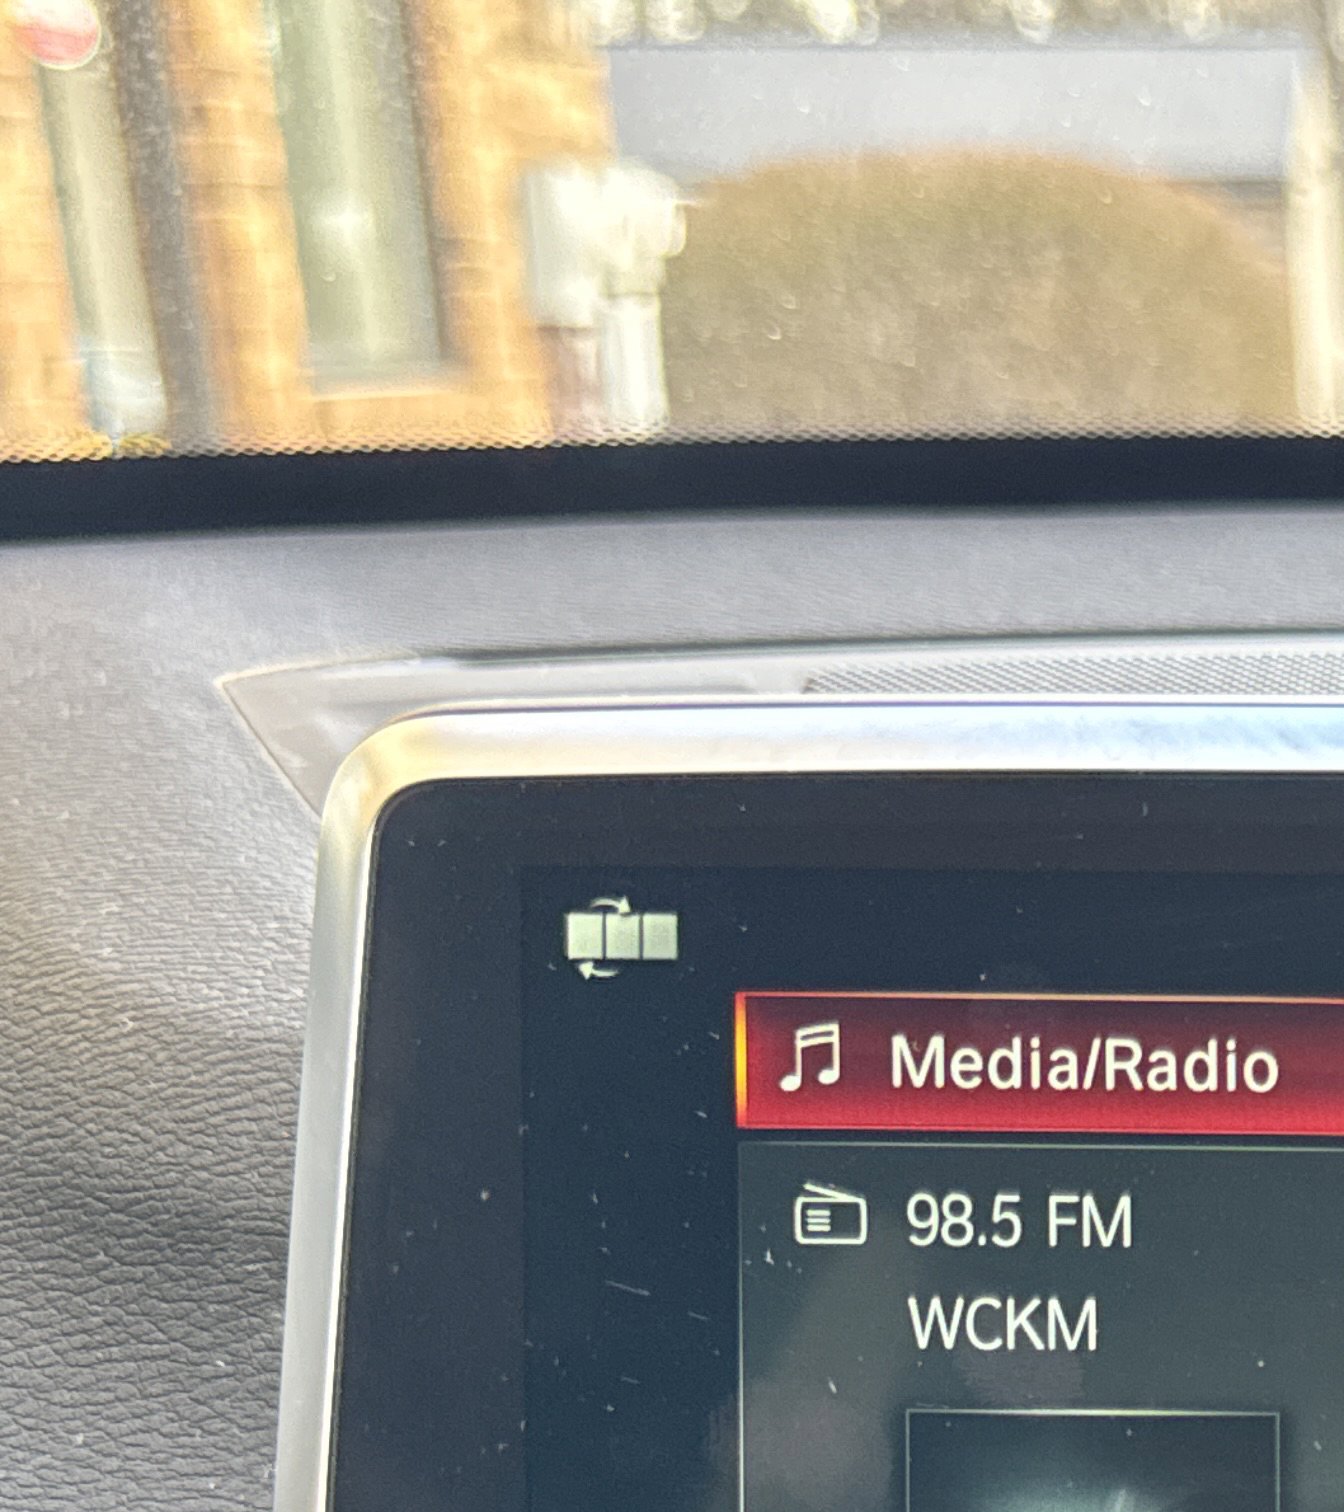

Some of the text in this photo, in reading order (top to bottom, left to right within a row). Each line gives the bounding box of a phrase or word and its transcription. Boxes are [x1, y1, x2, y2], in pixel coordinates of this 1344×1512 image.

[890, 1033, 1280, 1094] Media/Radio
[905, 1190, 1133, 1249] 98.5 FM
[906, 1294, 1099, 1352] WCKM
